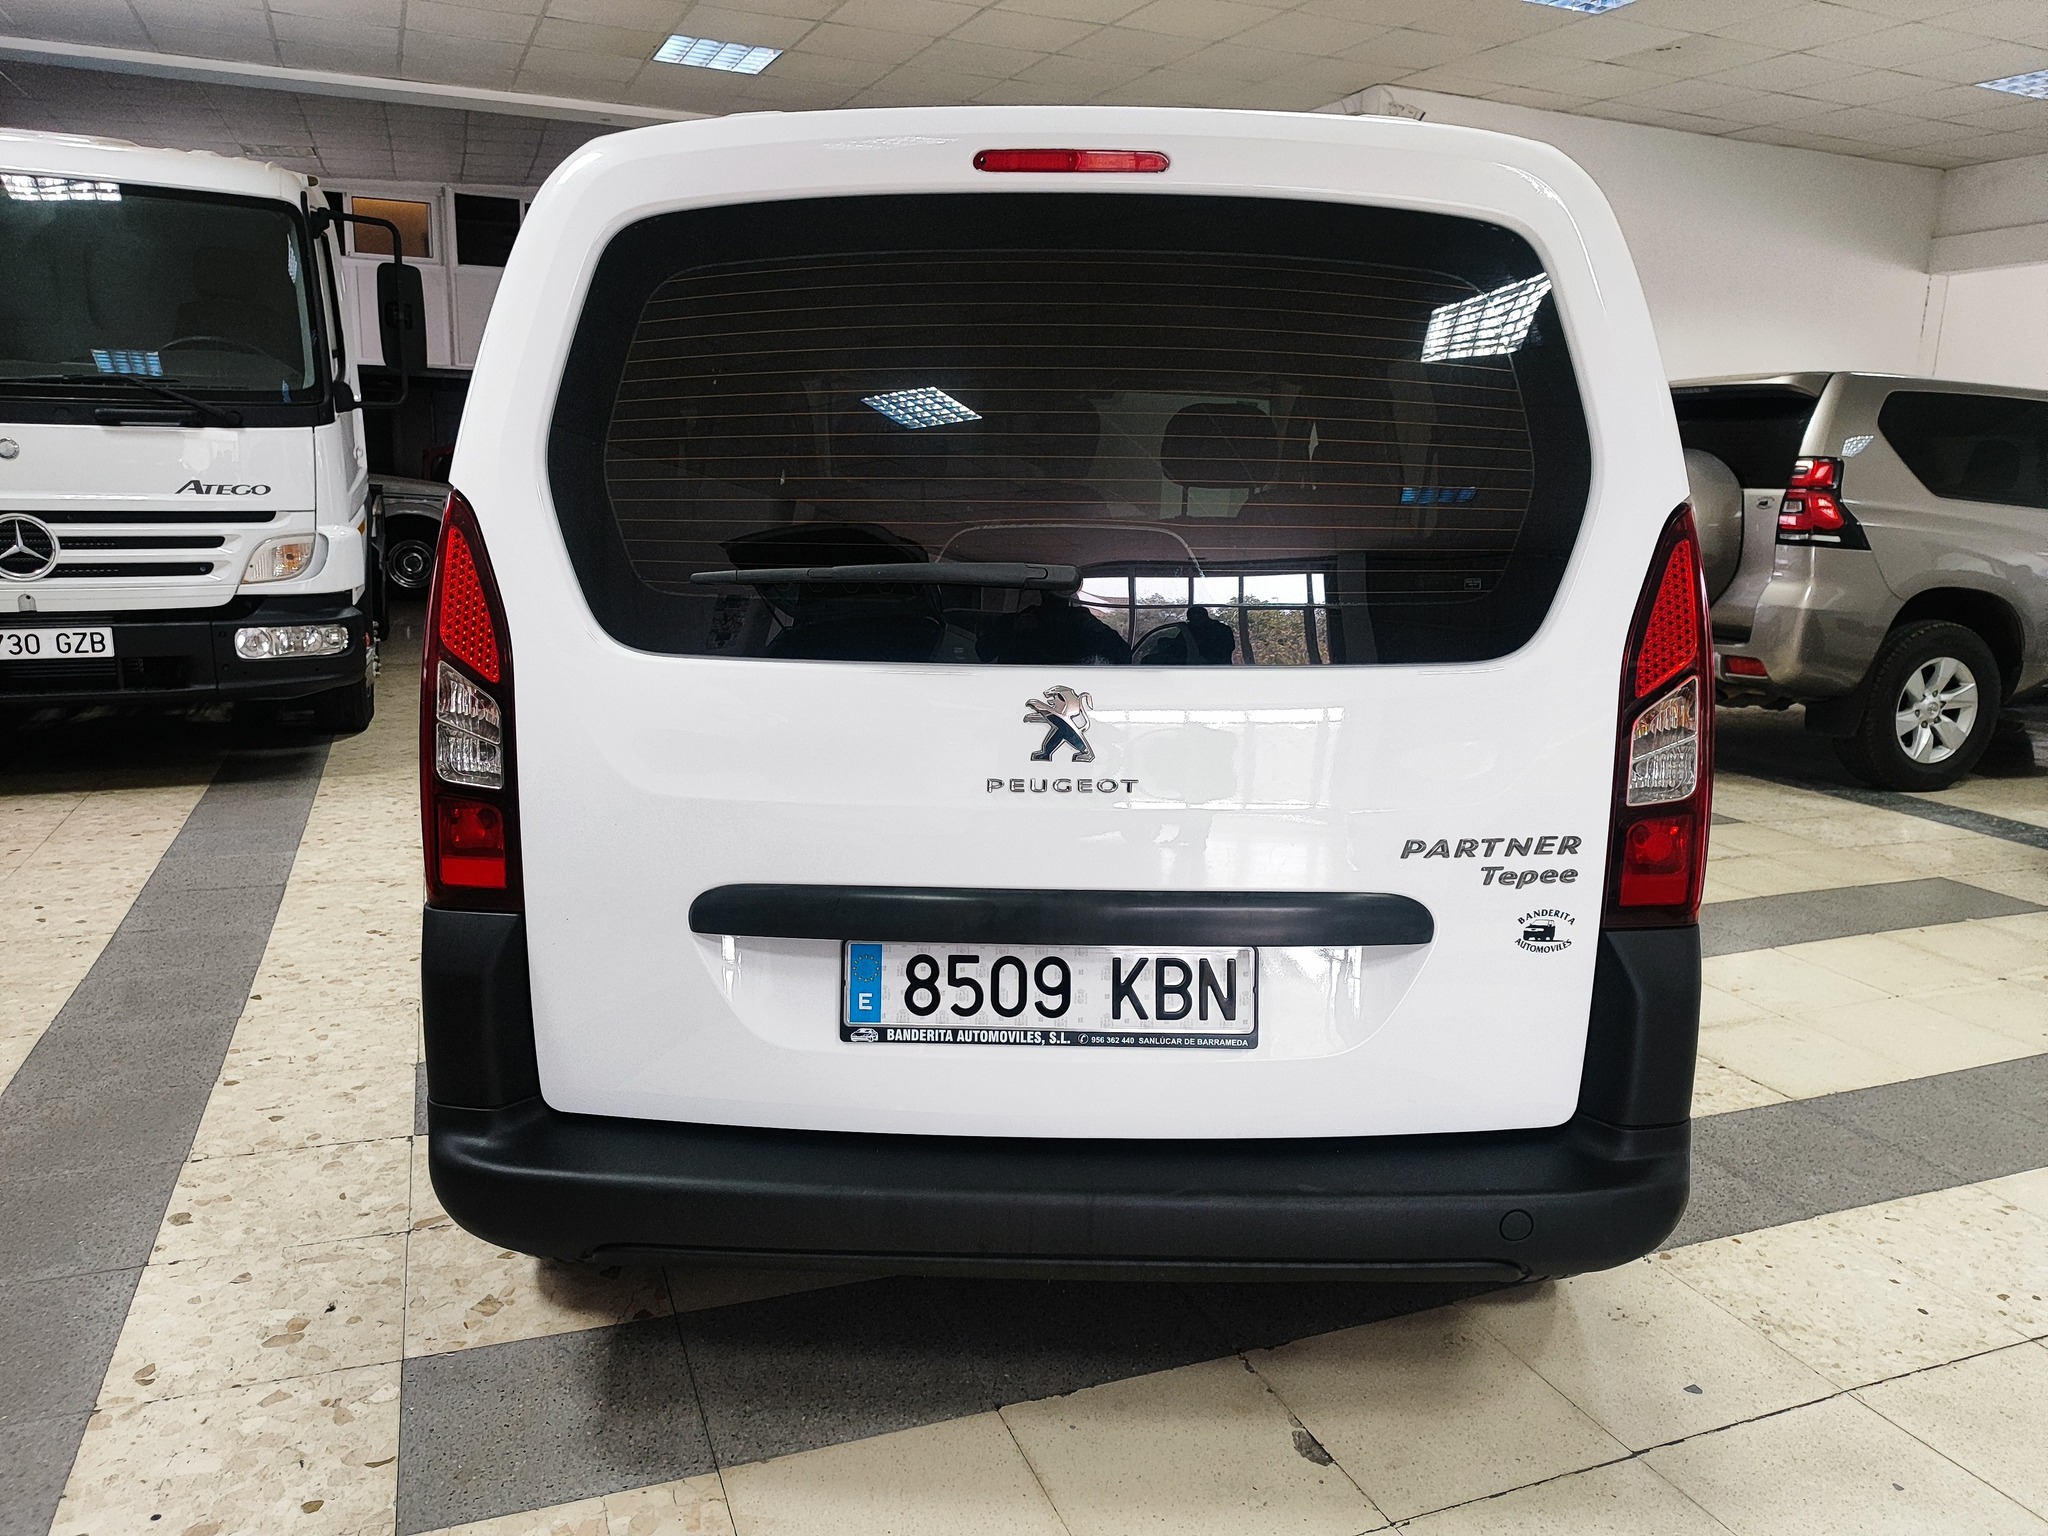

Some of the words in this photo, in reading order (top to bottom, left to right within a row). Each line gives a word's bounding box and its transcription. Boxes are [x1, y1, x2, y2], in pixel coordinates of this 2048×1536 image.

[175, 480, 272, 496] ATEGO
[0, 633, 41, 656] 30
[55, 631, 106, 654] GZB
[986, 778, 1139, 794] PEUGEOT
[1400, 835, 1582, 859] PARTNER
[1480, 866, 1579, 890] Tepee
[1517, 908, 1576, 926] BANDERITA
[1514, 938, 1572, 954] AUTOMOVILES
[904, 953, 1071, 1019] 8509
[1111, 957, 1237, 1021] KBN
[858, 993, 873, 1010] E
[886, 1028, 954, 1042] BANDERITA
[956, 1030, 1046, 1046] AUTOMOVILES,
[1048, 1031, 1071, 1045] S.L.
[1091, 1036, 1105, 1044] 956
[1106, 1036, 1120, 1045] 362
[1121, 1037, 1135, 1045] 440
[1138, 1036, 1183, 1046] SANLÚCAR
[1184, 1038, 1195, 1046] DE
[1197, 1038, 1249, 1047] BARRAMEDA
